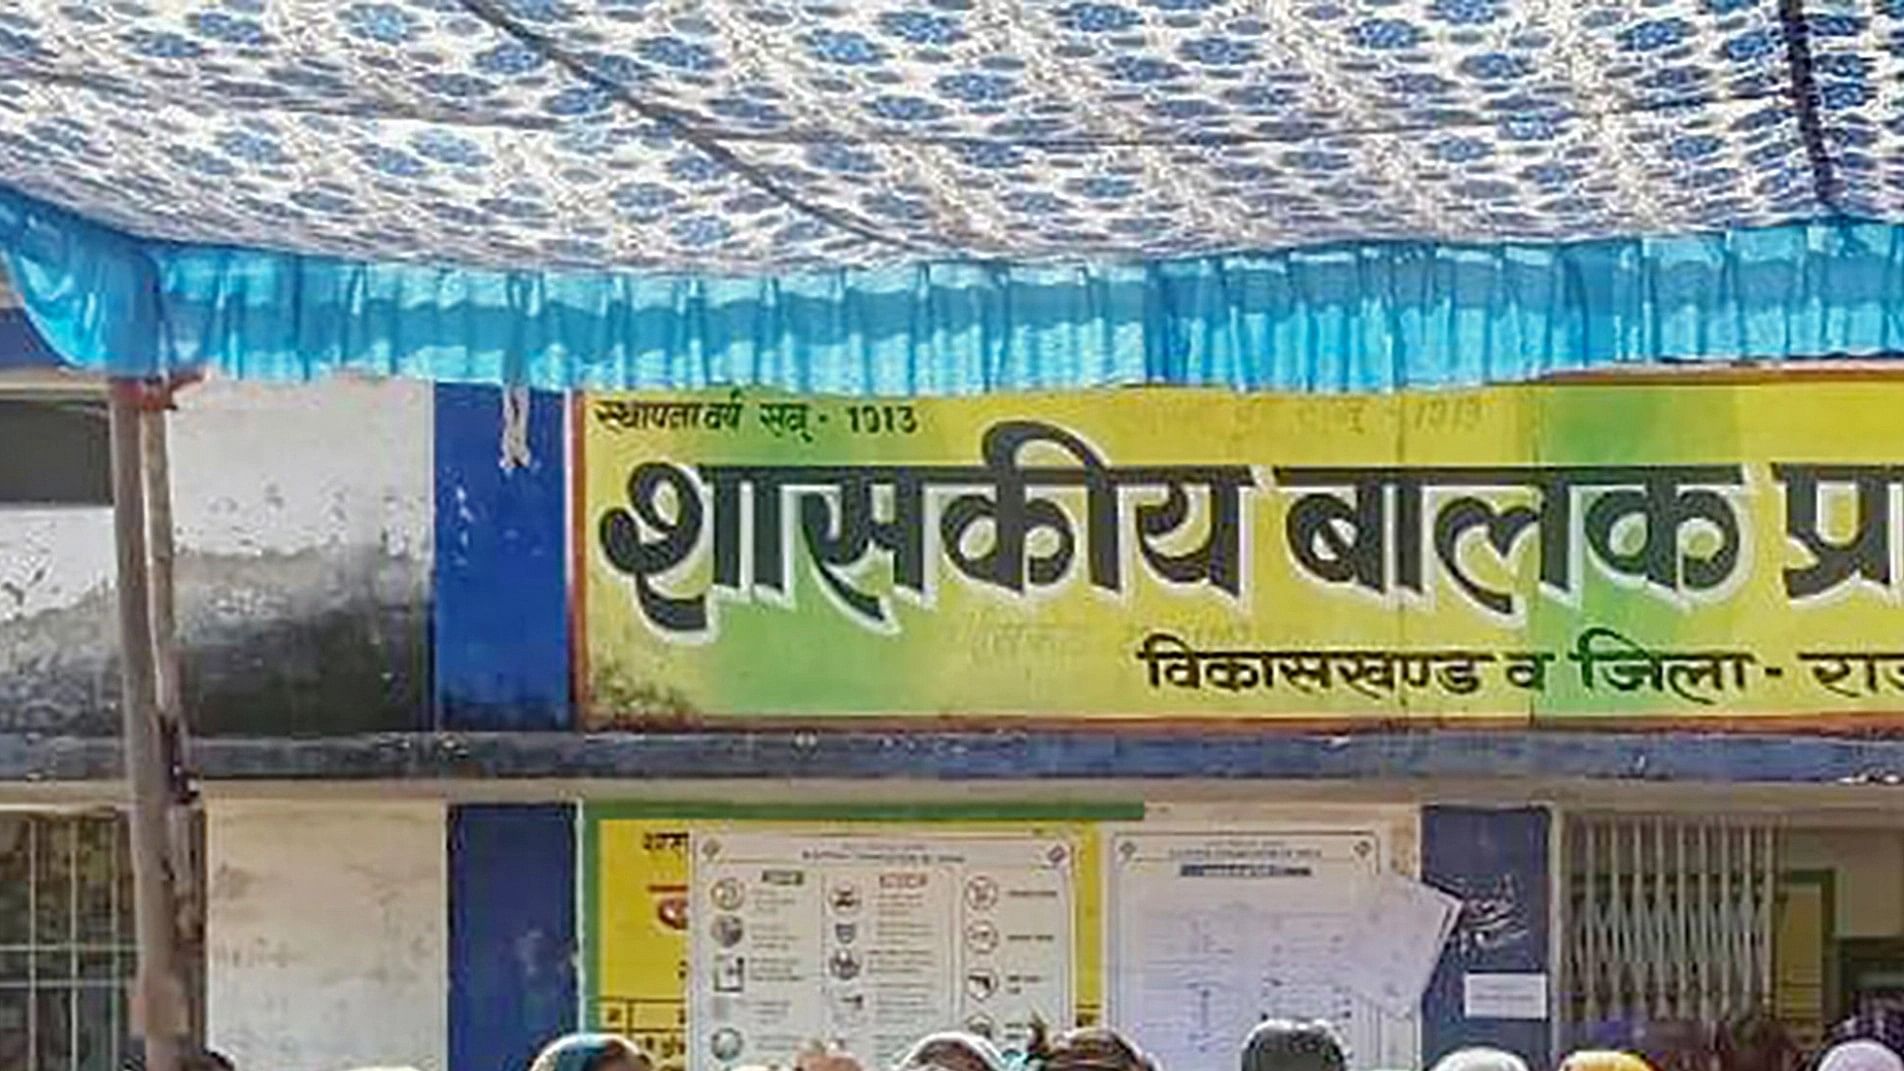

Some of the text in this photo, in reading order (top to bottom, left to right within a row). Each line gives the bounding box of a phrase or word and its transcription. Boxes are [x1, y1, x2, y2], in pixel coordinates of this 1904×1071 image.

[598, 420, 1254, 632] शासकीय
[1274, 464, 1744, 616] बालक
[1137, 633, 1496, 705] विकासखण्ड
[1503, 654, 1554, 690] व
